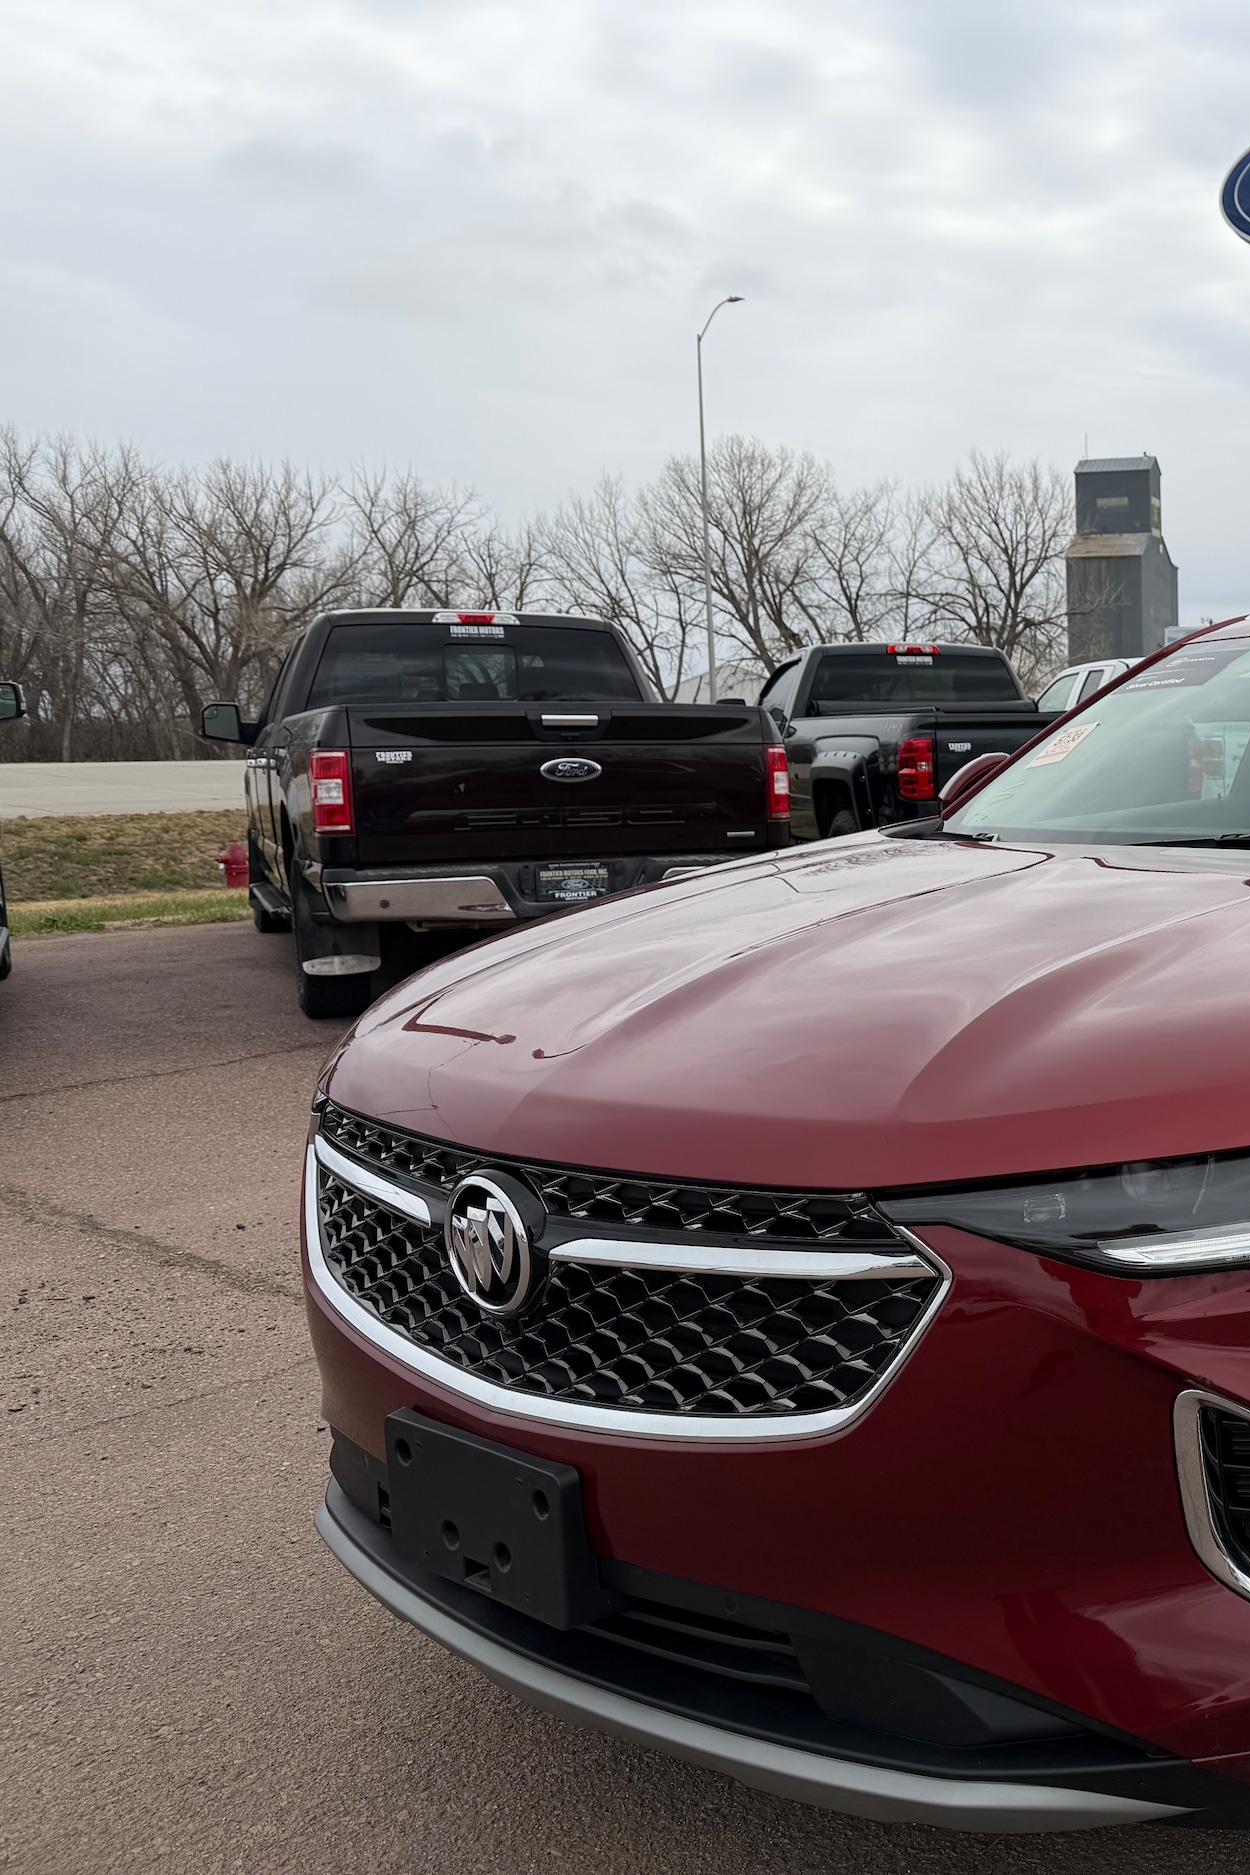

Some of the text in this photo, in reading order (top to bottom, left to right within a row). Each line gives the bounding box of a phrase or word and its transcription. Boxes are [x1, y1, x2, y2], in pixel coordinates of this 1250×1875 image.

[449, 625, 504, 634] FRONTIER MOTORS
[555, 762, 588, 777] Ford
[555, 890, 597, 898] FRONTIER
